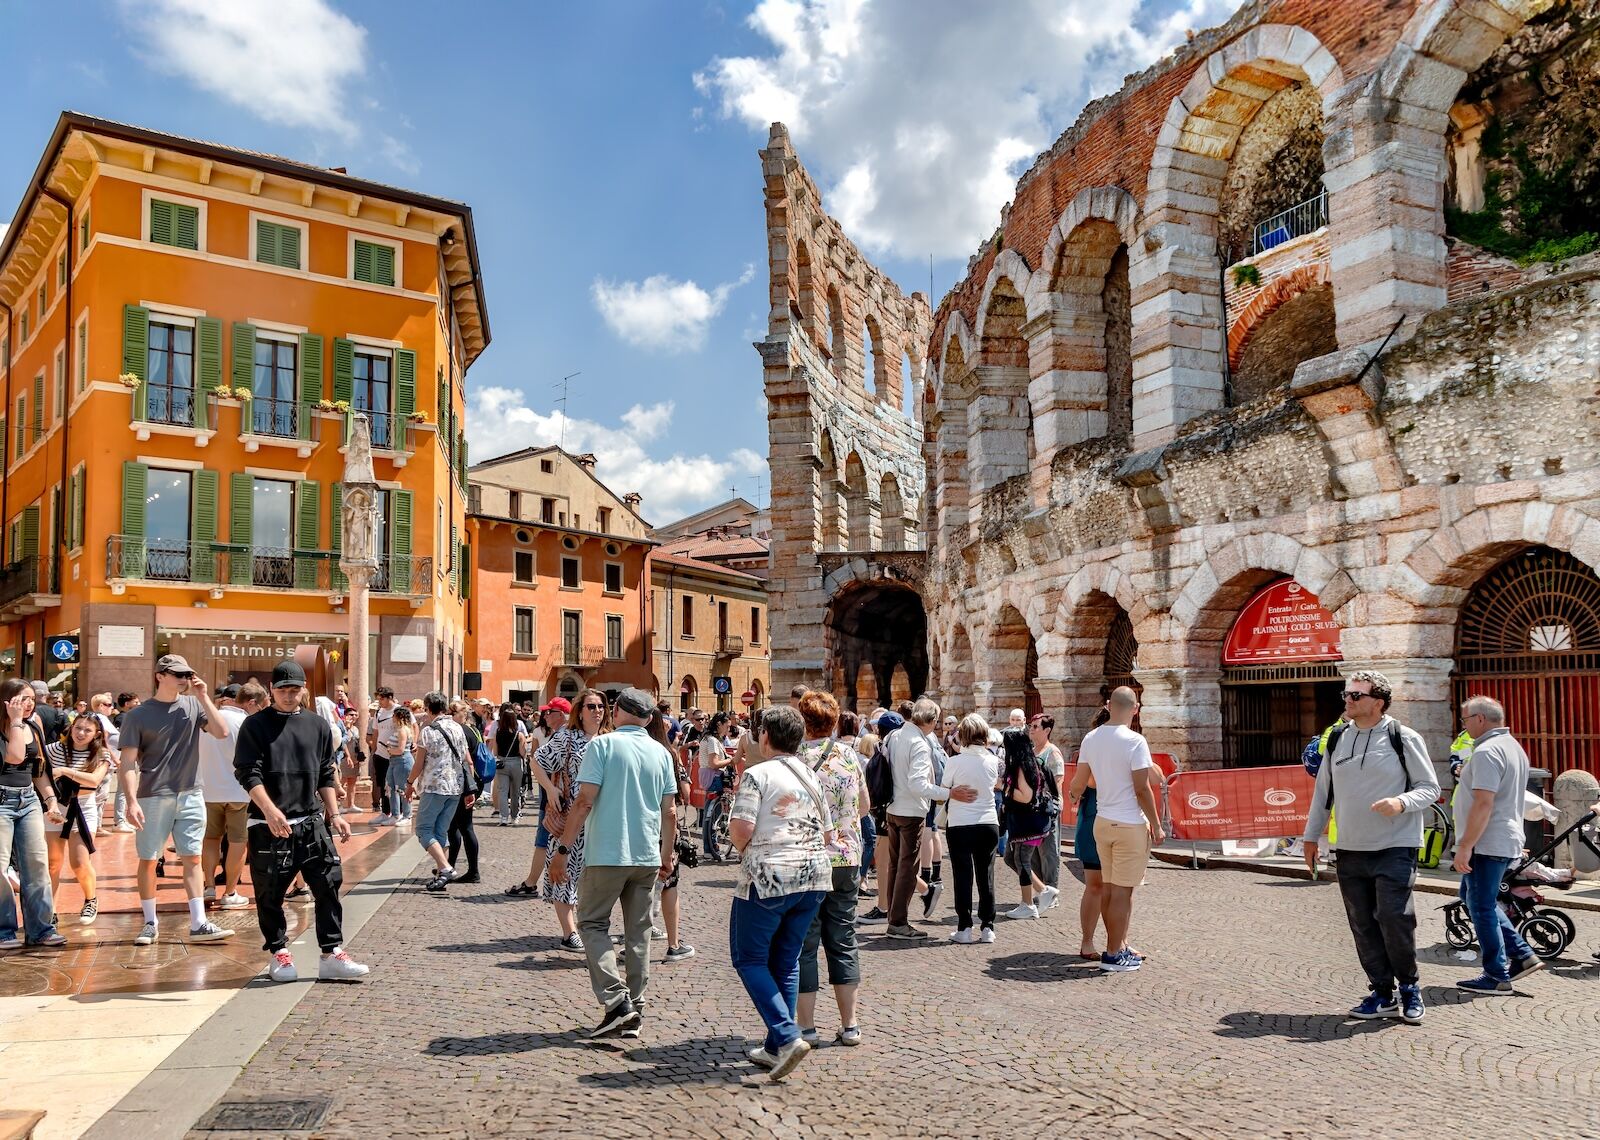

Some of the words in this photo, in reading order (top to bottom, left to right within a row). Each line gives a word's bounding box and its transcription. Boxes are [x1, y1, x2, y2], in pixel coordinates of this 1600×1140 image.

[1300, 603, 1318, 611] Gate
[1269, 613, 1320, 624] POLTRONISSIME
[1253, 625, 1287, 634] PLATINUM
[1291, 623, 1311, 631] GOLD
